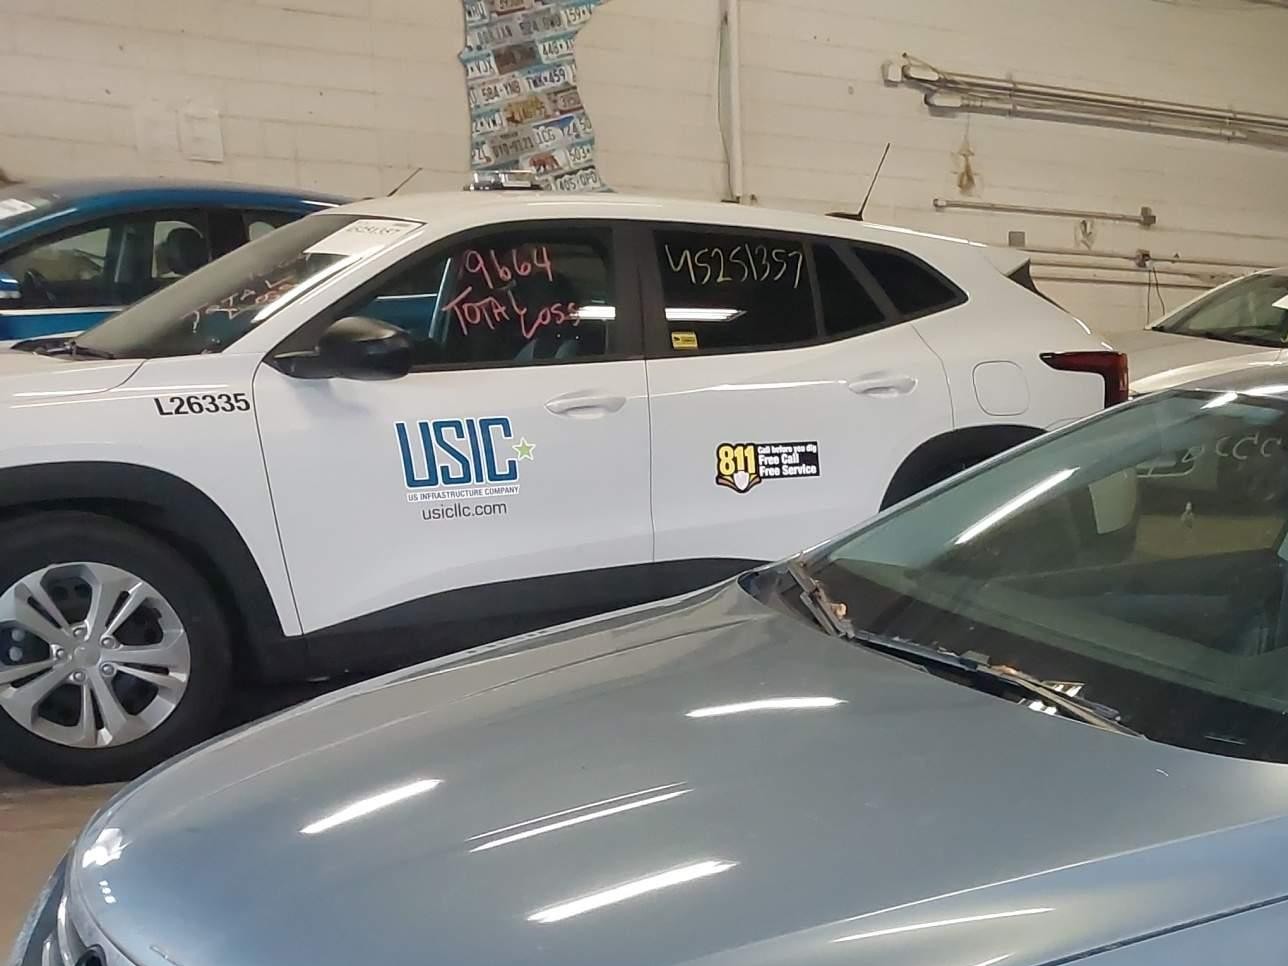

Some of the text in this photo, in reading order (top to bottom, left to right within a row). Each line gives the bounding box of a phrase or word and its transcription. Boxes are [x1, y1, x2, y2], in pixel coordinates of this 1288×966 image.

[465, 247, 552, 289] 9664
[665, 243, 803, 288] 45251357
[442, 286, 527, 336] TOTAL
[153, 392, 251, 416] L26335
[395, 416, 519, 489] USIC
[718, 444, 757, 476] 811
[758, 453, 800, 465] Free Call
[759, 464, 817, 477] Free Service
[408, 486, 519, 502] US INFRASTRUCTURE COMPANY
[422, 502, 508, 521] usicllc.com
